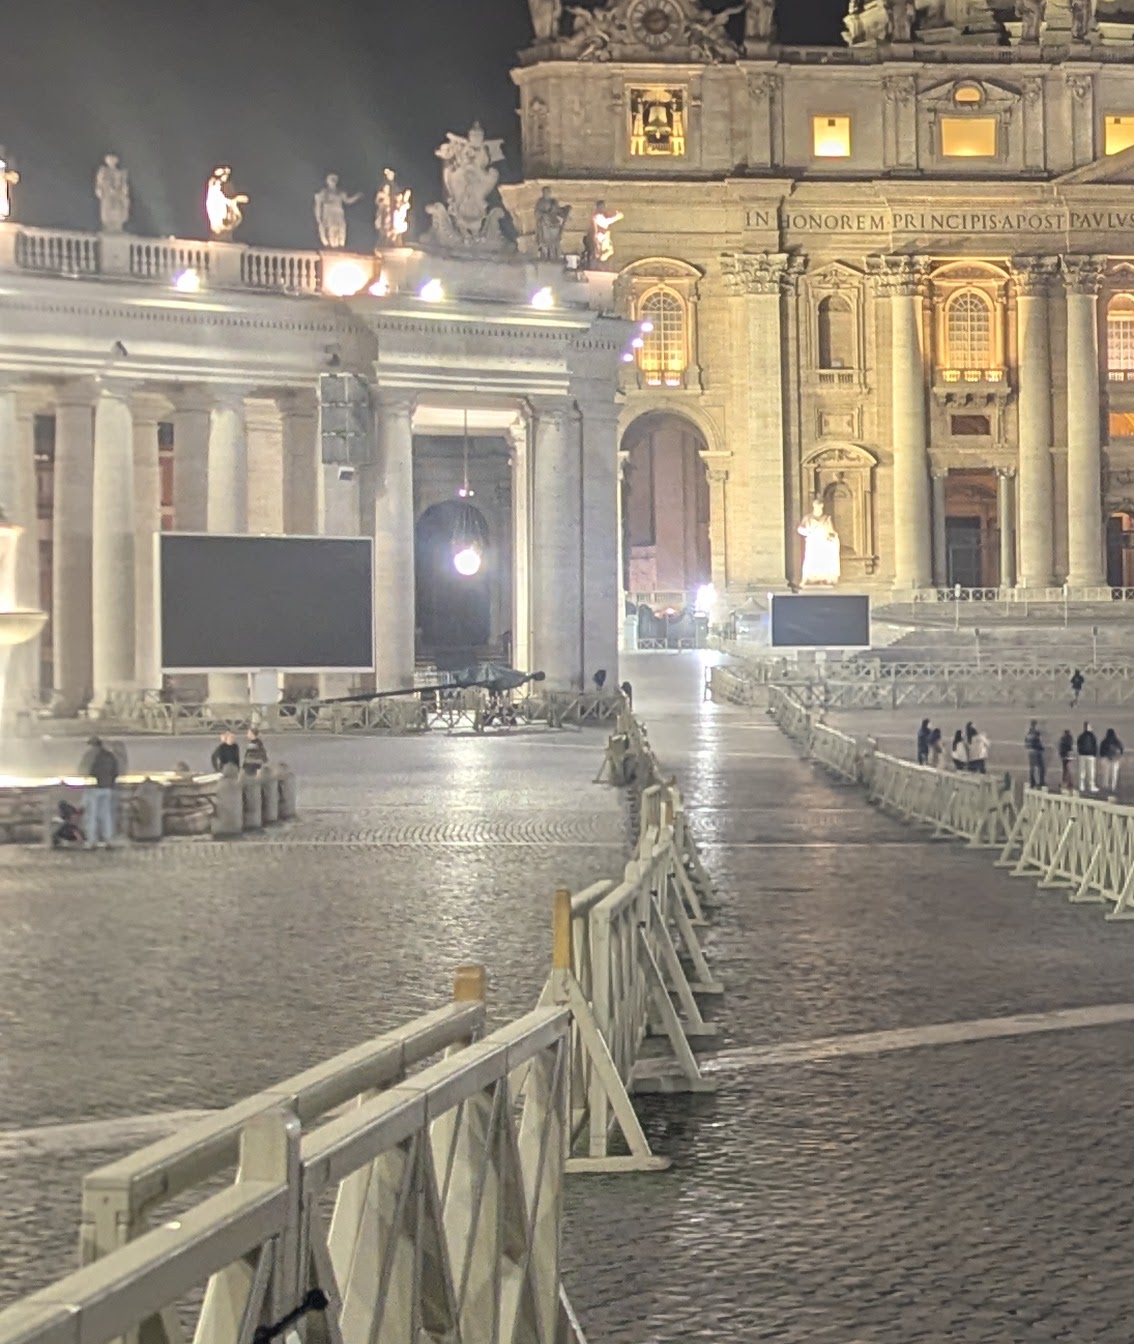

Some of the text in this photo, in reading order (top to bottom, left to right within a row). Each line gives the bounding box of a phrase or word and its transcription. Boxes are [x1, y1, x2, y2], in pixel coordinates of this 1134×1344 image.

[745, 211, 770, 227] IN
[781, 214, 885, 231] HONOREM
[892, 212, 998, 230] PRINCIPIS
[1001, 213, 1065, 230] APOST
